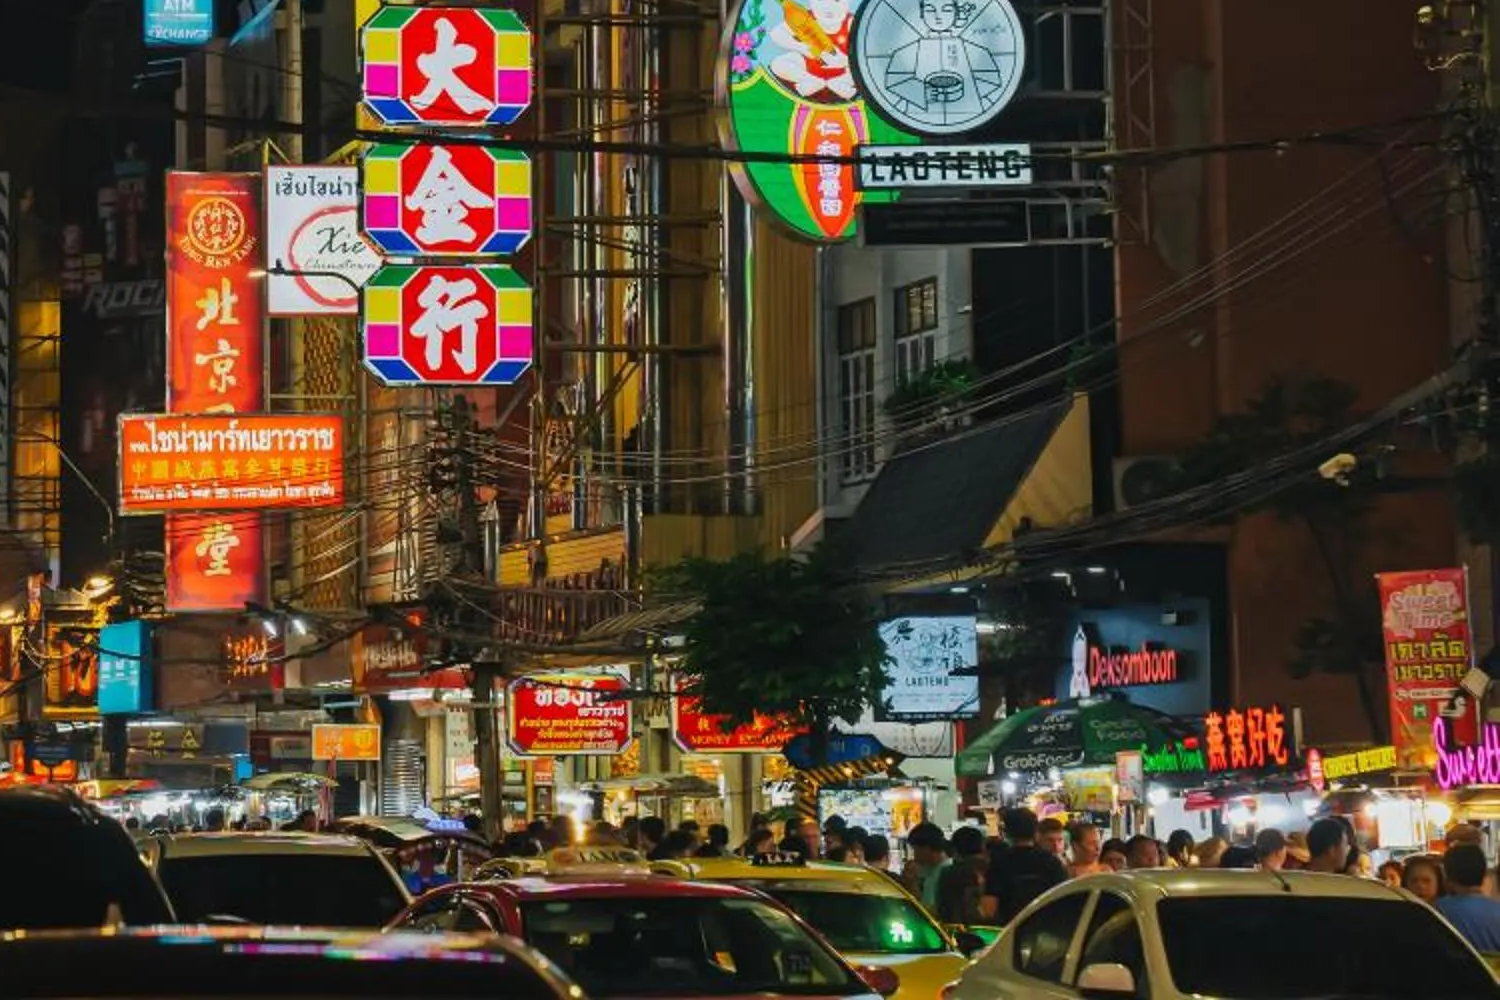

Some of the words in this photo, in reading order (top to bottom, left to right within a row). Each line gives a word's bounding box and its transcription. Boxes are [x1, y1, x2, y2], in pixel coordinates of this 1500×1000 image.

[870, 150, 1022, 181] LAOTENG
[316, 227, 367, 255] Xie
[204, 254, 232, 269] REN
[83, 279, 164, 317] ROC
